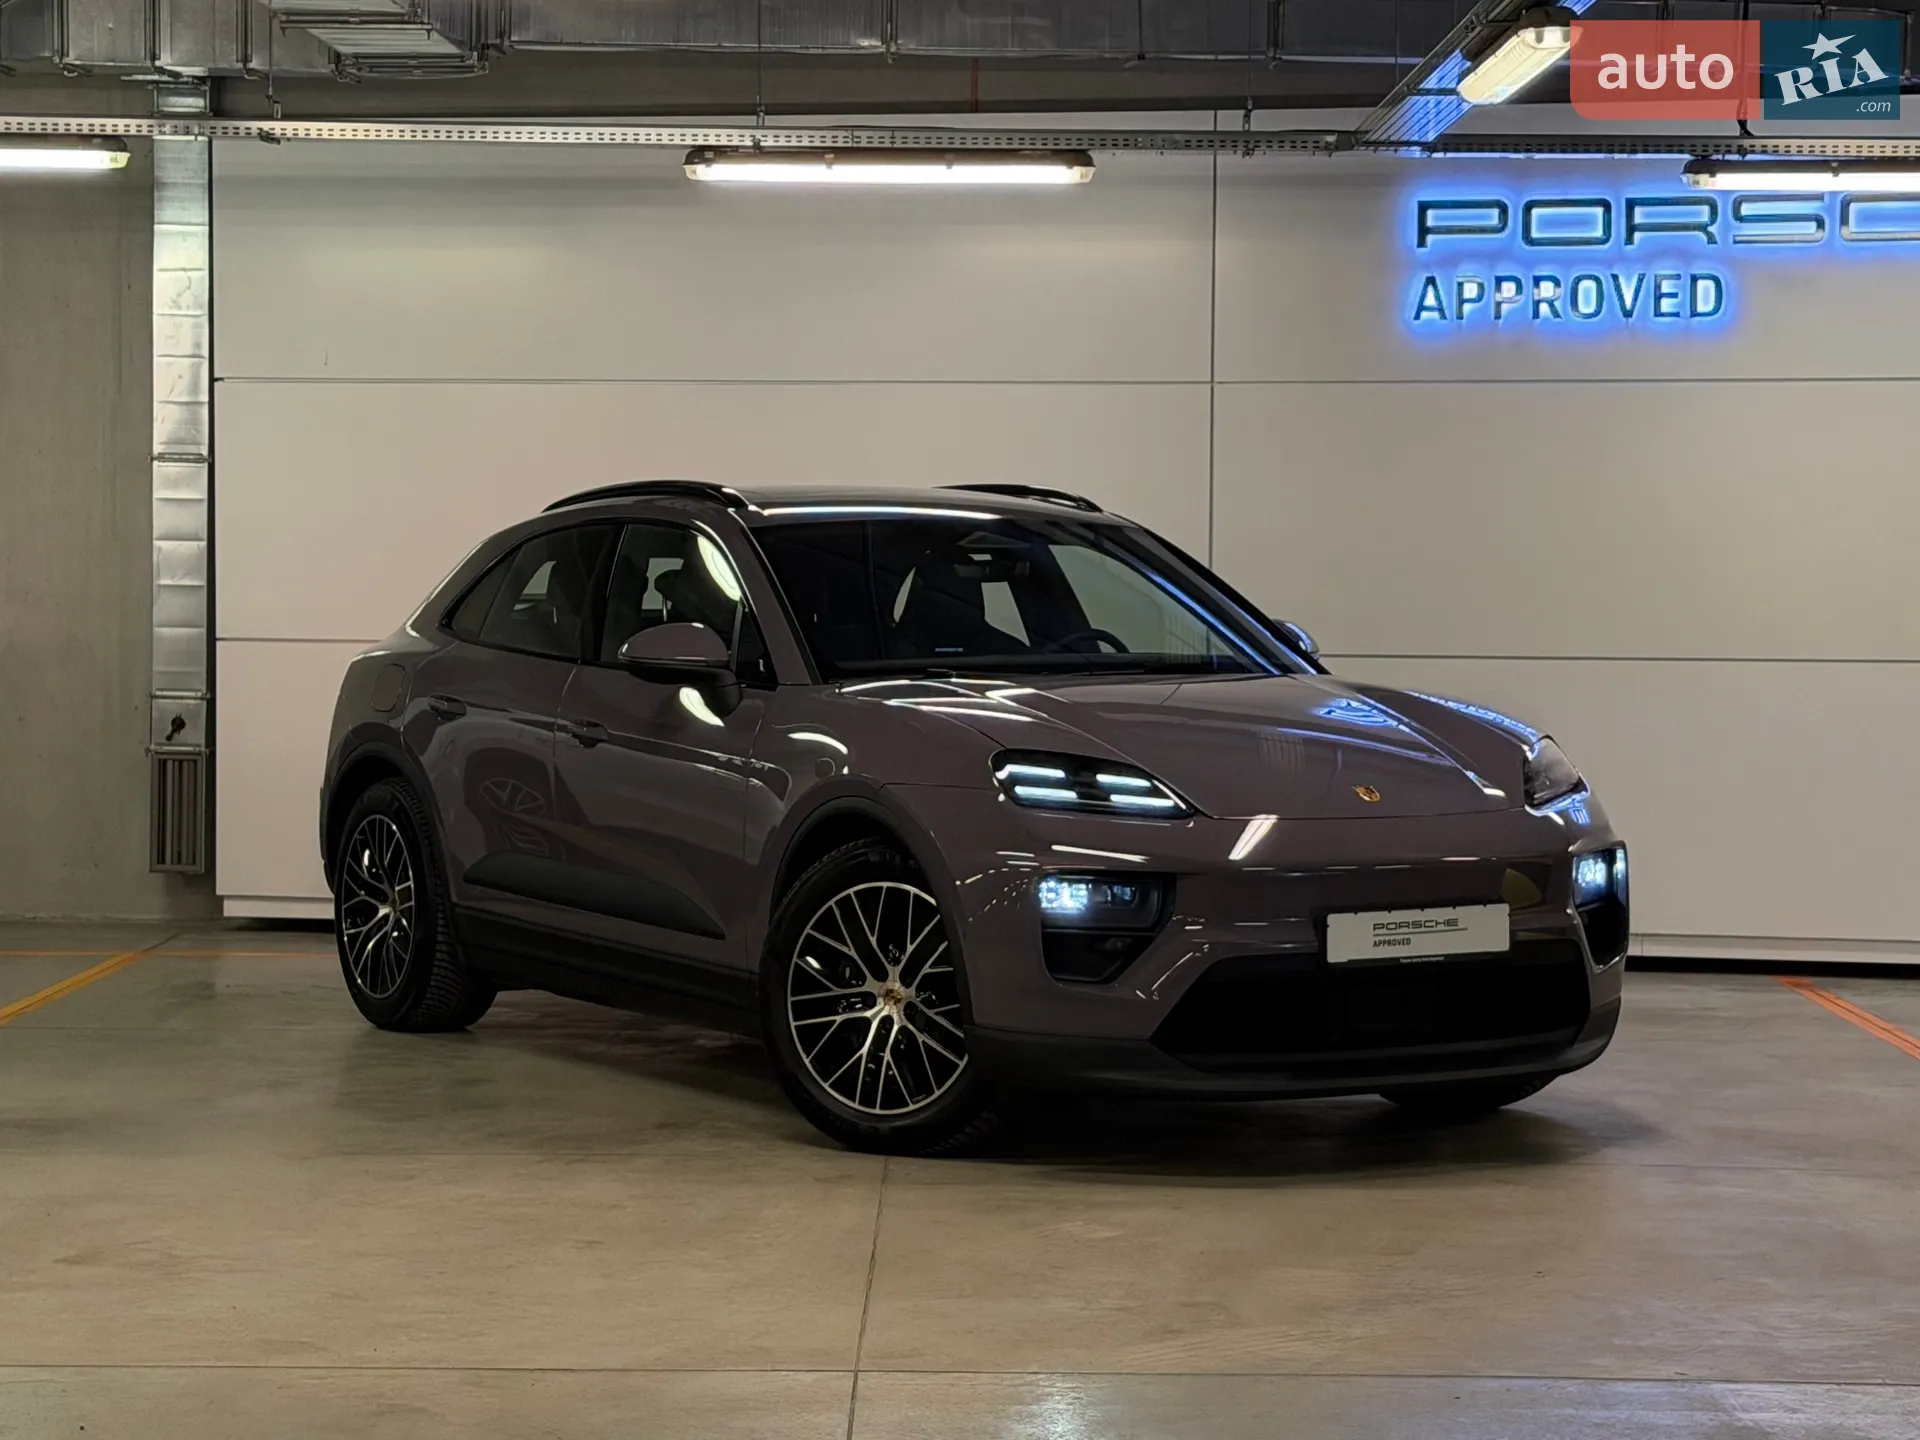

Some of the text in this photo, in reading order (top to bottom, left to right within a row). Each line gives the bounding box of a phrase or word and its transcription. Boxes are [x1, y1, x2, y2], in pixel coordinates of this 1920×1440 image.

[1413, 272, 1724, 321] APPROVED
[1372, 918, 1459, 932] PORSCHE
[1372, 937, 1412, 948] APPROVED
